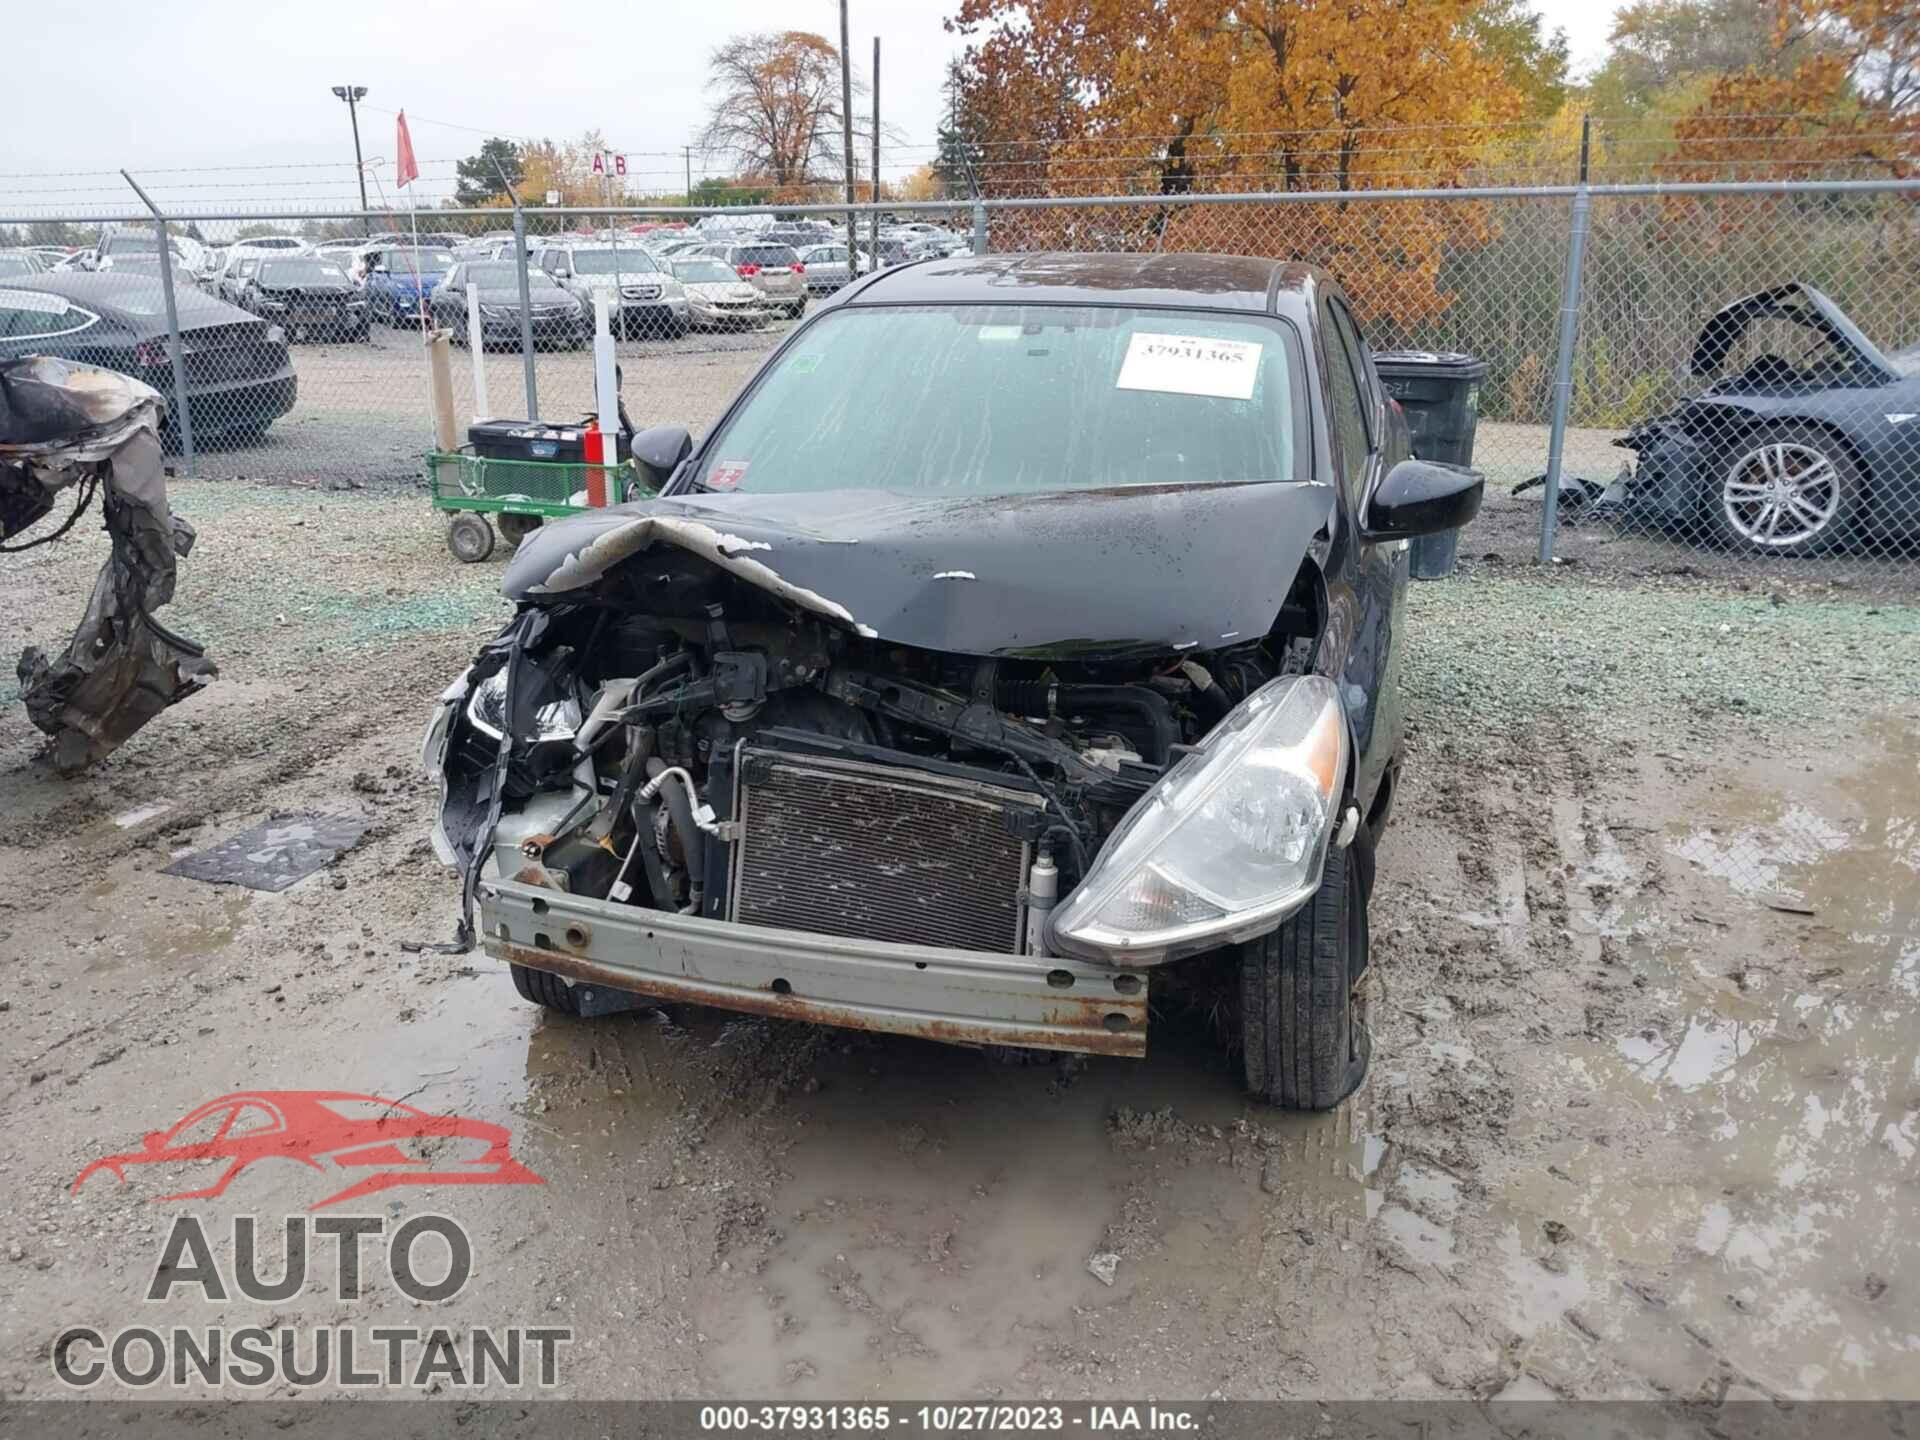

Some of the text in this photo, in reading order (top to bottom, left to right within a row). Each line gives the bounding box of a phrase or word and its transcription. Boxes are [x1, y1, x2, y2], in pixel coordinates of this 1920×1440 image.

[593, 152, 604, 173] A
[615, 155, 626, 175] B
[1141, 344, 1246, 363] 37931365
